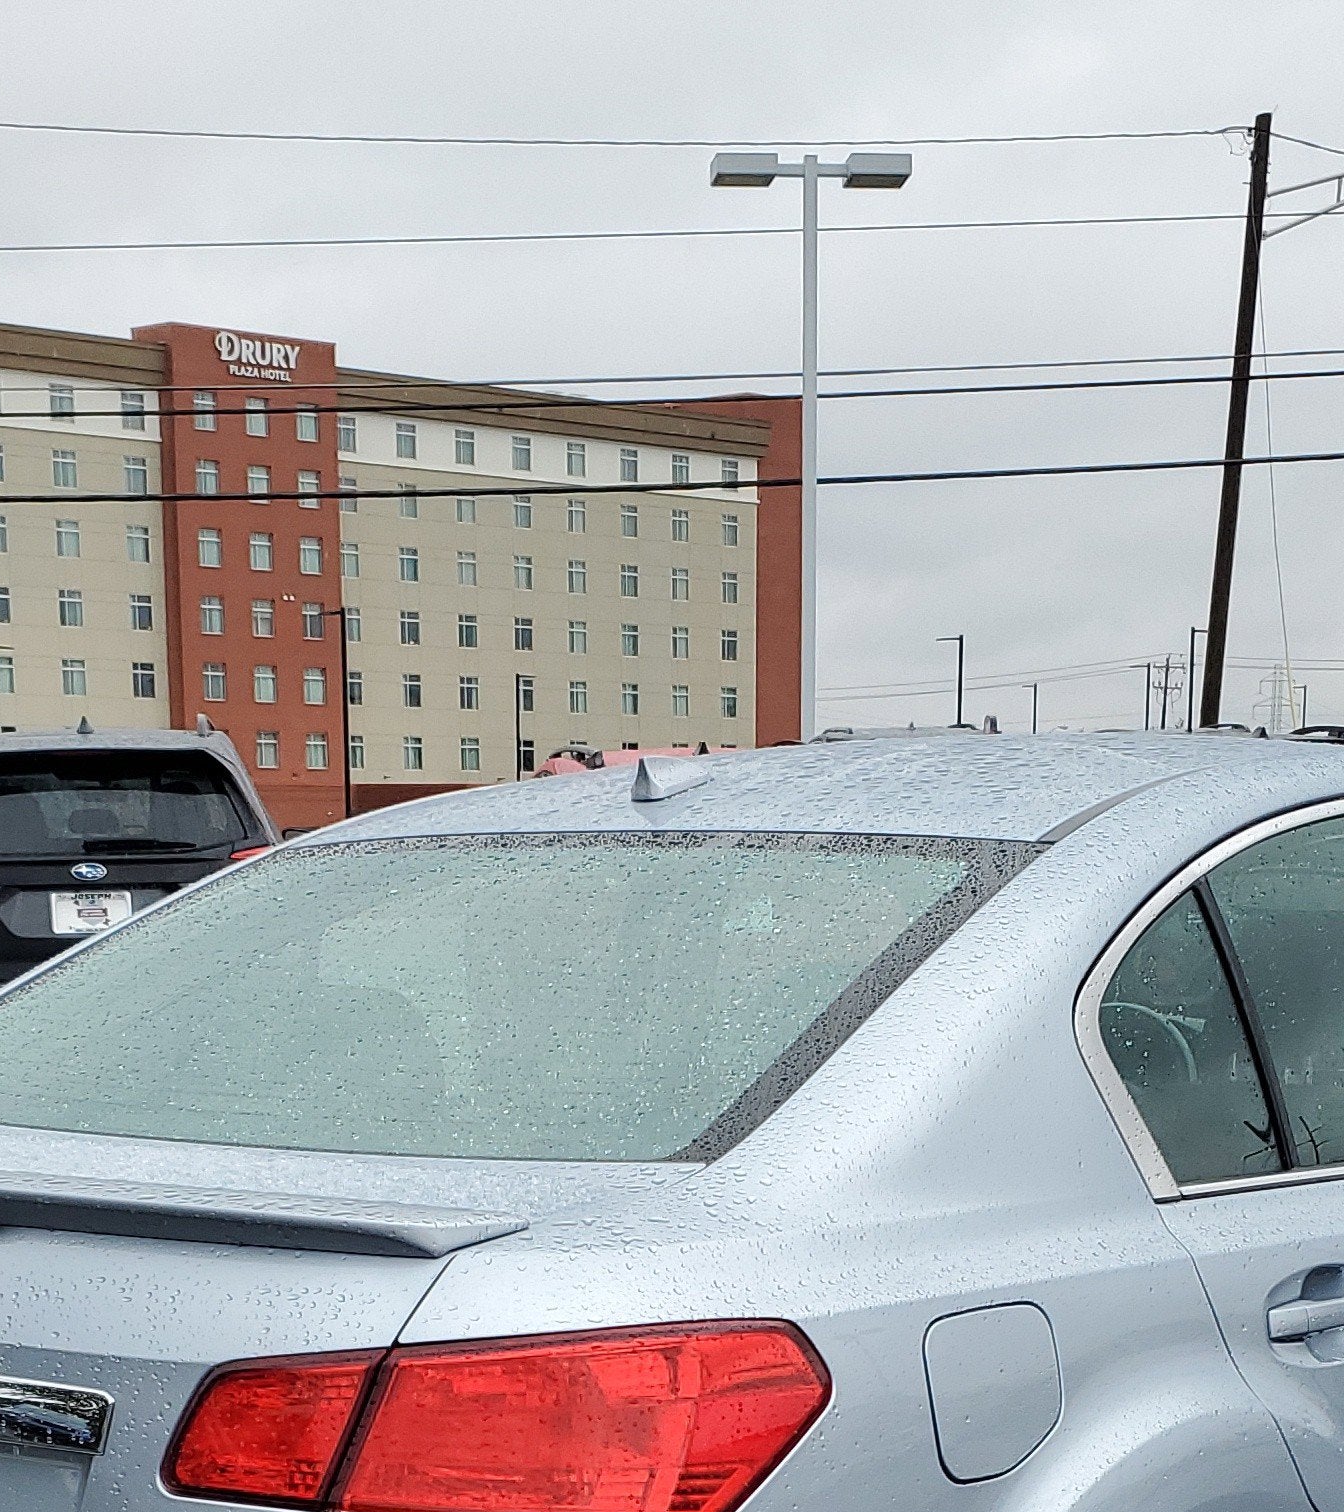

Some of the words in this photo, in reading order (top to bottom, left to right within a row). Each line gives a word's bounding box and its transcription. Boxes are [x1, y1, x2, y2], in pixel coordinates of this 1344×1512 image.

[215, 331, 301, 370] DRURY
[229, 364, 260, 378] PLAZA
[260, 368, 293, 383] HOTEL
